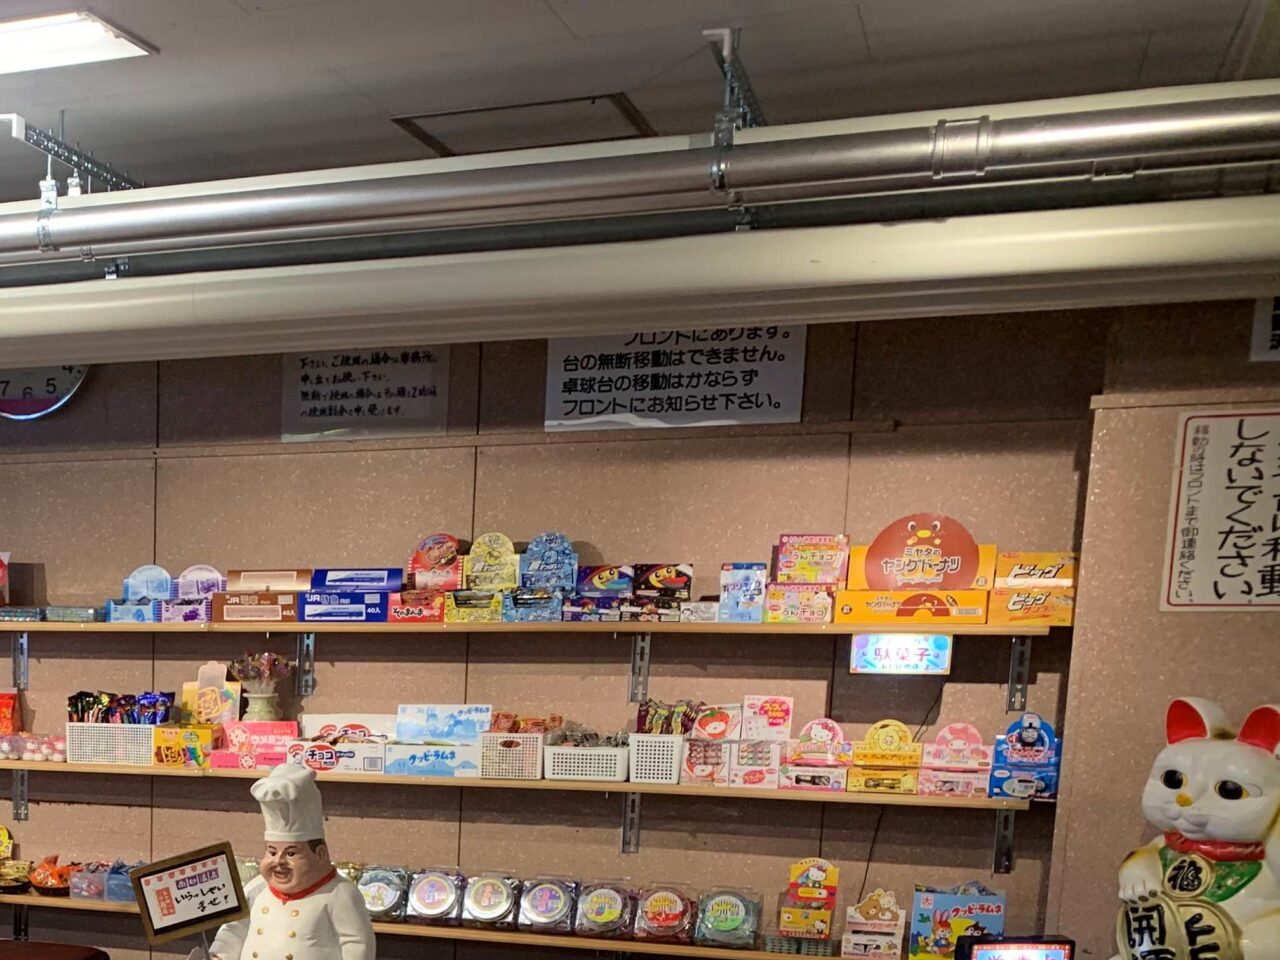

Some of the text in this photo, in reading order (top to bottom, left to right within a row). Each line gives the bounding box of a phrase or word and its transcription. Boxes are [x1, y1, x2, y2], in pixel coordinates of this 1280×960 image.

[563, 345, 785, 371] 台の無断移動はできません。
[0, 381, 10, 396] 7
[46, 378, 56, 393] 5
[561, 368, 759, 394] 卓球台の移動はかならず
[23, 387, 33, 399] 6
[564, 392, 781, 416] フロントにお知らせ下さい。
[905, 547, 940, 557] ミヤタの
[883, 559, 960, 575] ヤングドーナツ
